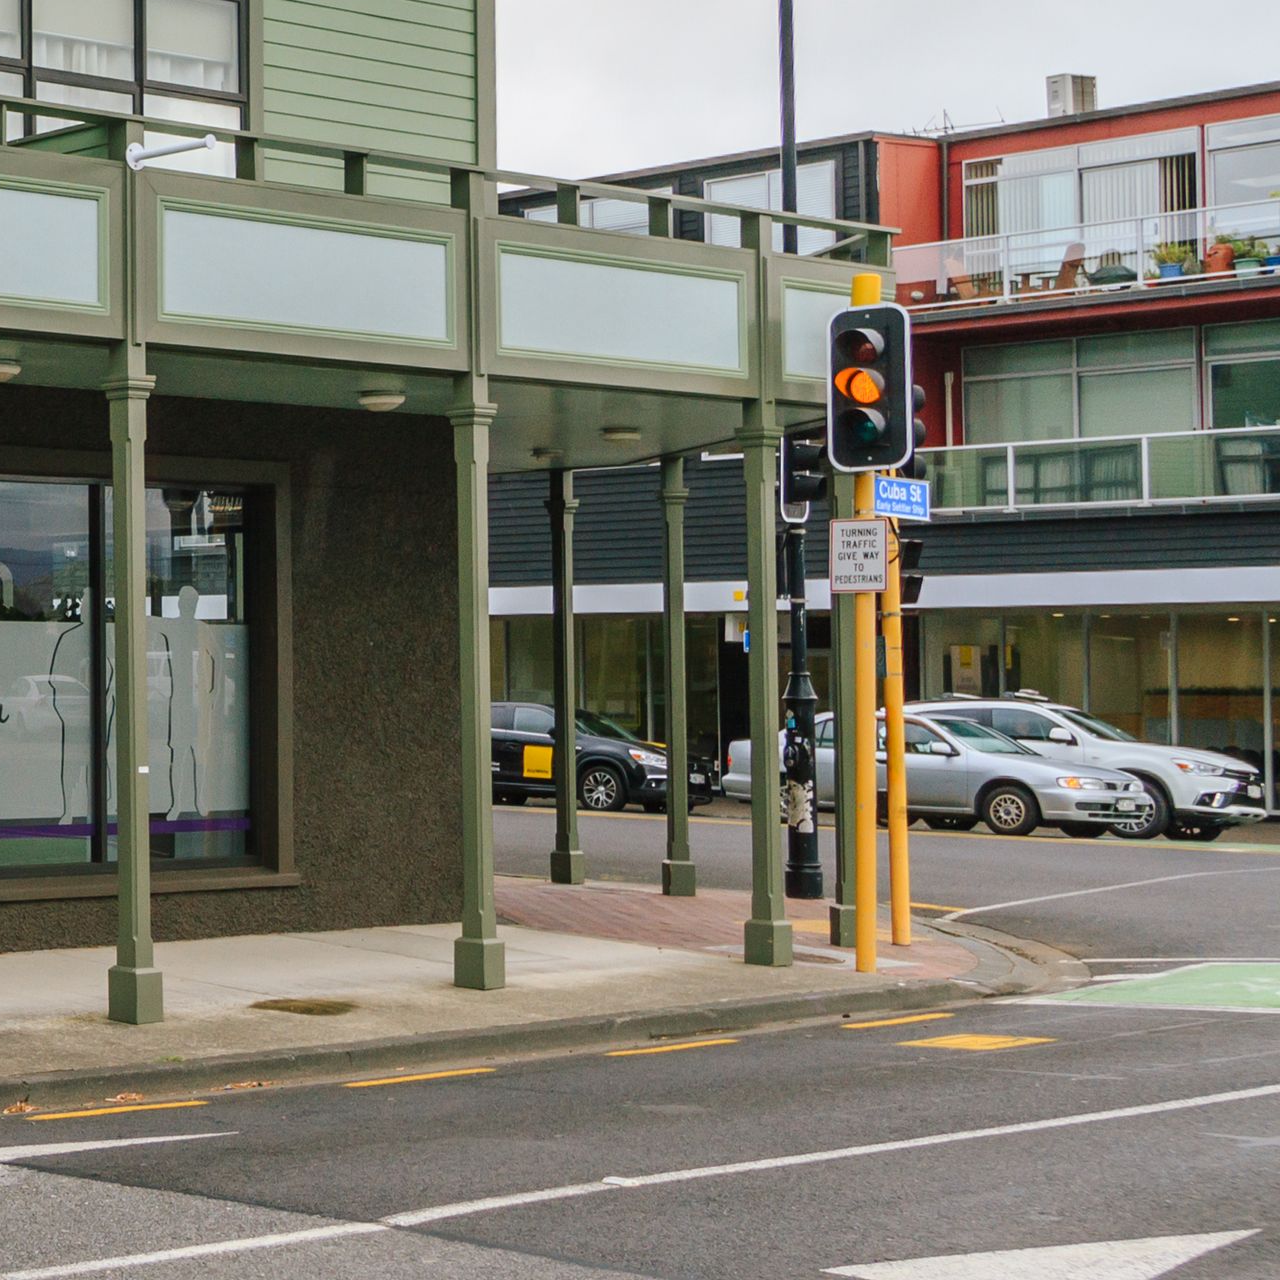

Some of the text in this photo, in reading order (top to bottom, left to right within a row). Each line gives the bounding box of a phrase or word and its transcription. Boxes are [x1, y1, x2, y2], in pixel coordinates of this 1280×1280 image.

[879, 481, 921, 502] Cuba St
[841, 528, 878, 538] TURNING
[841, 540, 877, 549] TRAFFIC
[838, 551, 880, 561] GIVE WAY
[854, 563, 864, 572] TO
[835, 574, 883, 584] PEDESTRIANS
